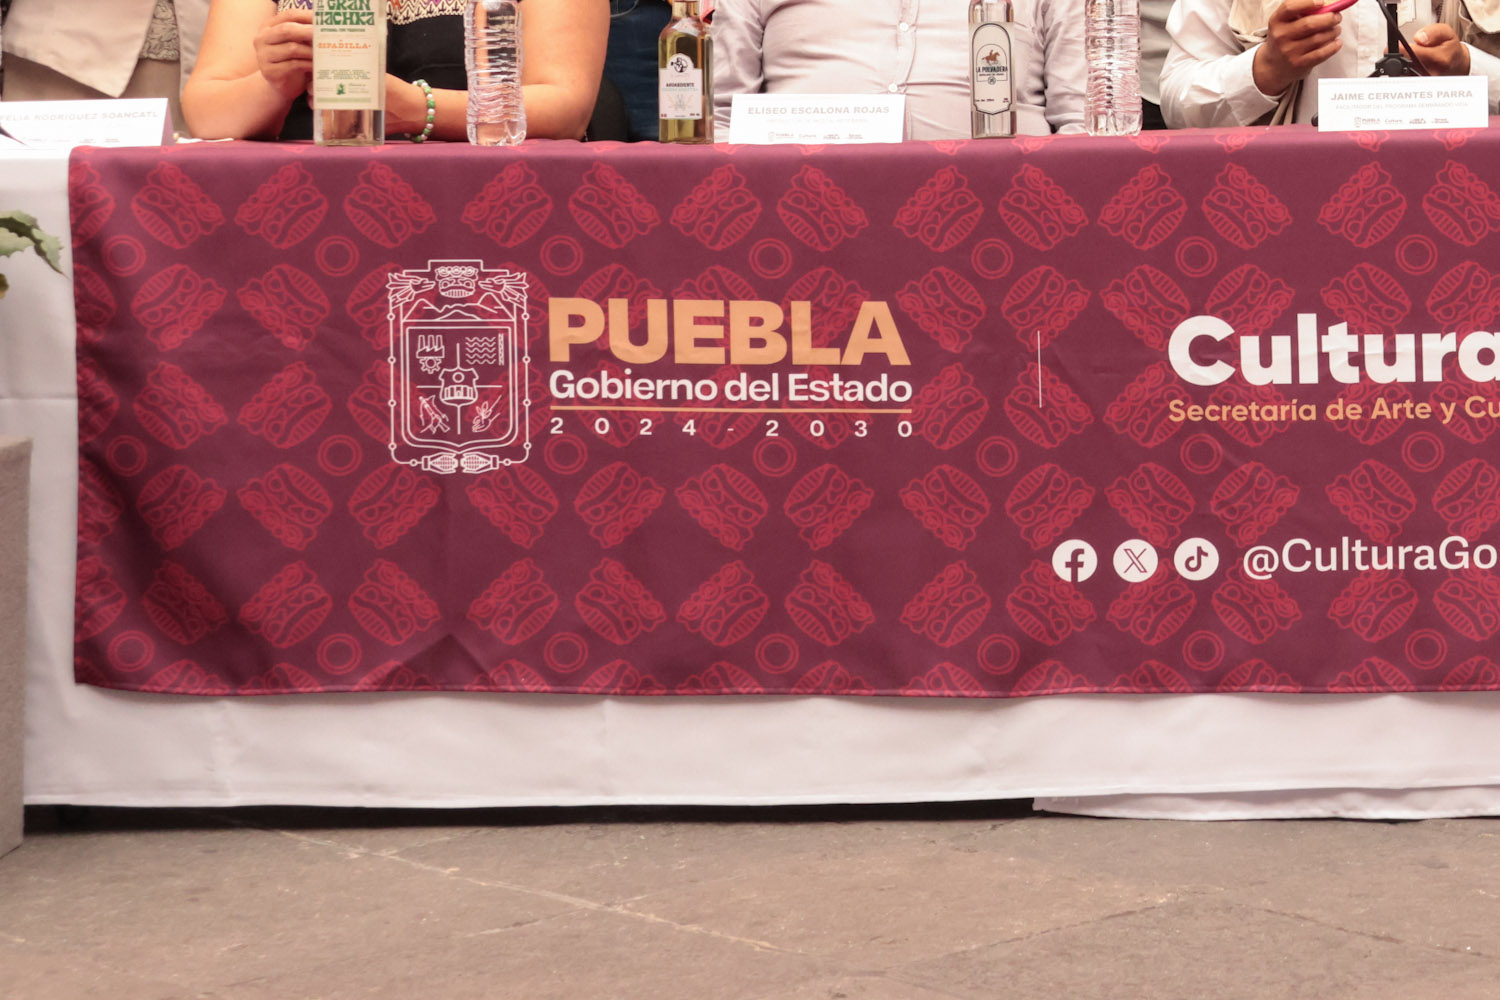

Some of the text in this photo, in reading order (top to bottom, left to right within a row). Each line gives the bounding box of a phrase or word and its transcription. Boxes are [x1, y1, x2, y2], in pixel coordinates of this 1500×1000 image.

[1331, 90, 1473, 101] JAIME CERVANTES PARRA
[791, 106, 850, 114] ESCALONA
[853, 106, 889, 114] ROJAS
[549, 298, 911, 365] PUEBLA
[550, 369, 912, 402] Gobierno del Estado
[1169, 398, 1317, 422] Secretaría
[1325, 399, 1362, 421] de
[1371, 397, 1432, 419] Arte
[1441, 402, 1456, 424] y
